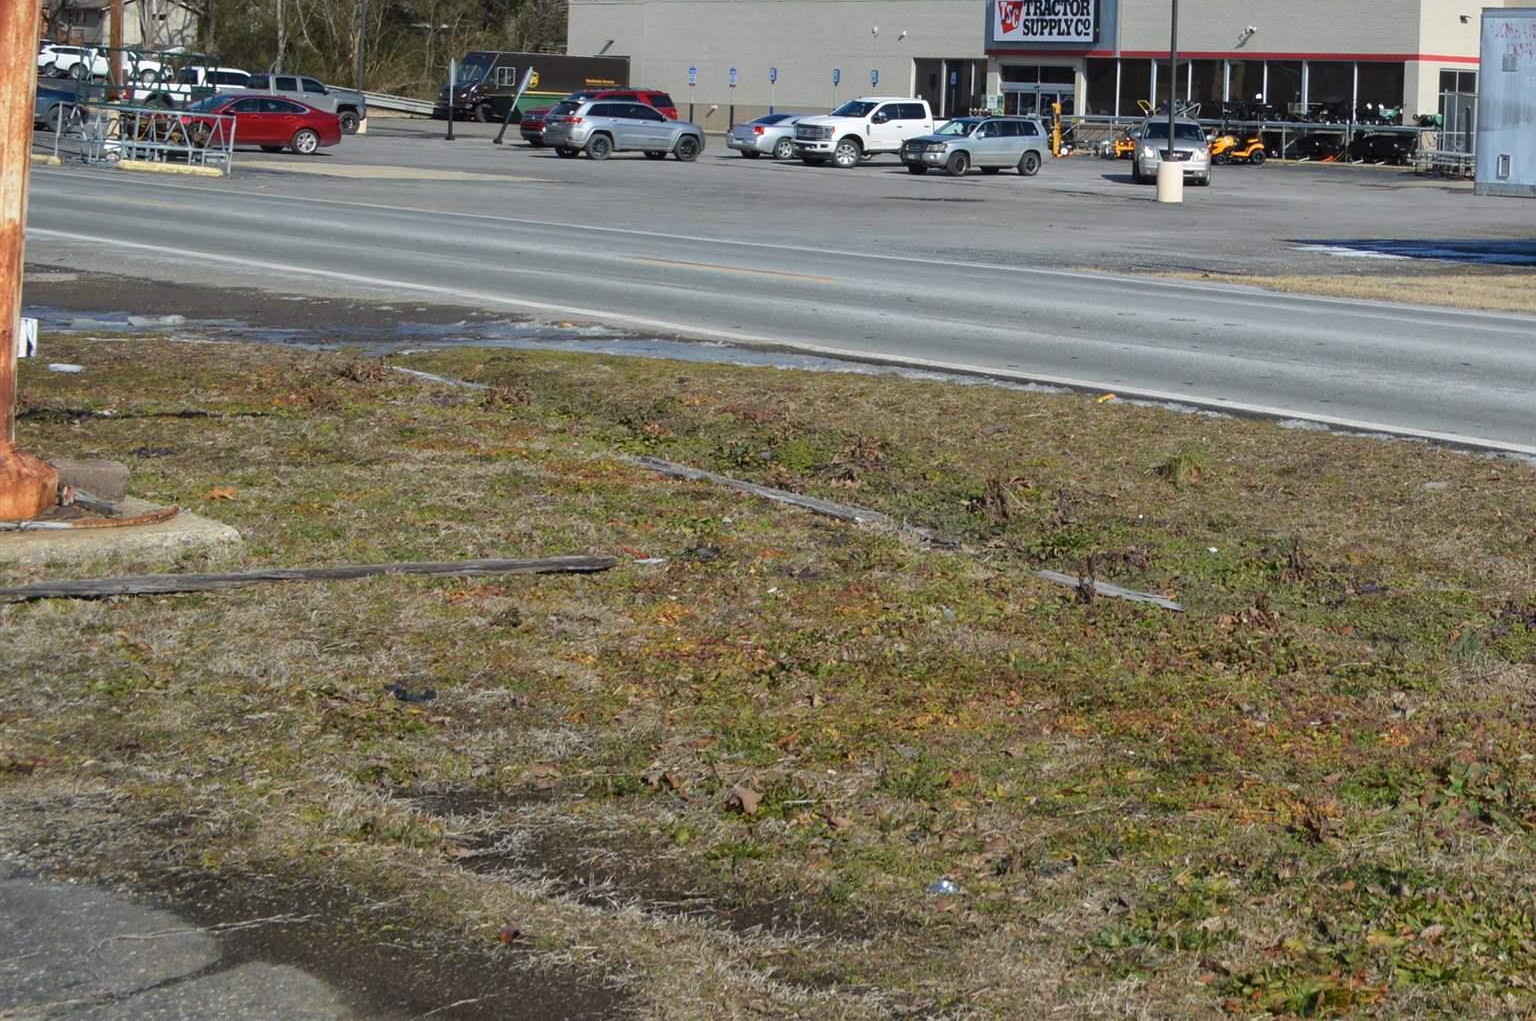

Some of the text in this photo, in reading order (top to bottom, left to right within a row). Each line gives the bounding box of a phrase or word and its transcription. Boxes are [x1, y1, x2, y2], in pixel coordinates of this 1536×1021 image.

[1000, 1, 1019, 28] TSC
[1023, 0, 1091, 16] TRACTOR
[1022, 18, 1073, 36] SUPPLY
